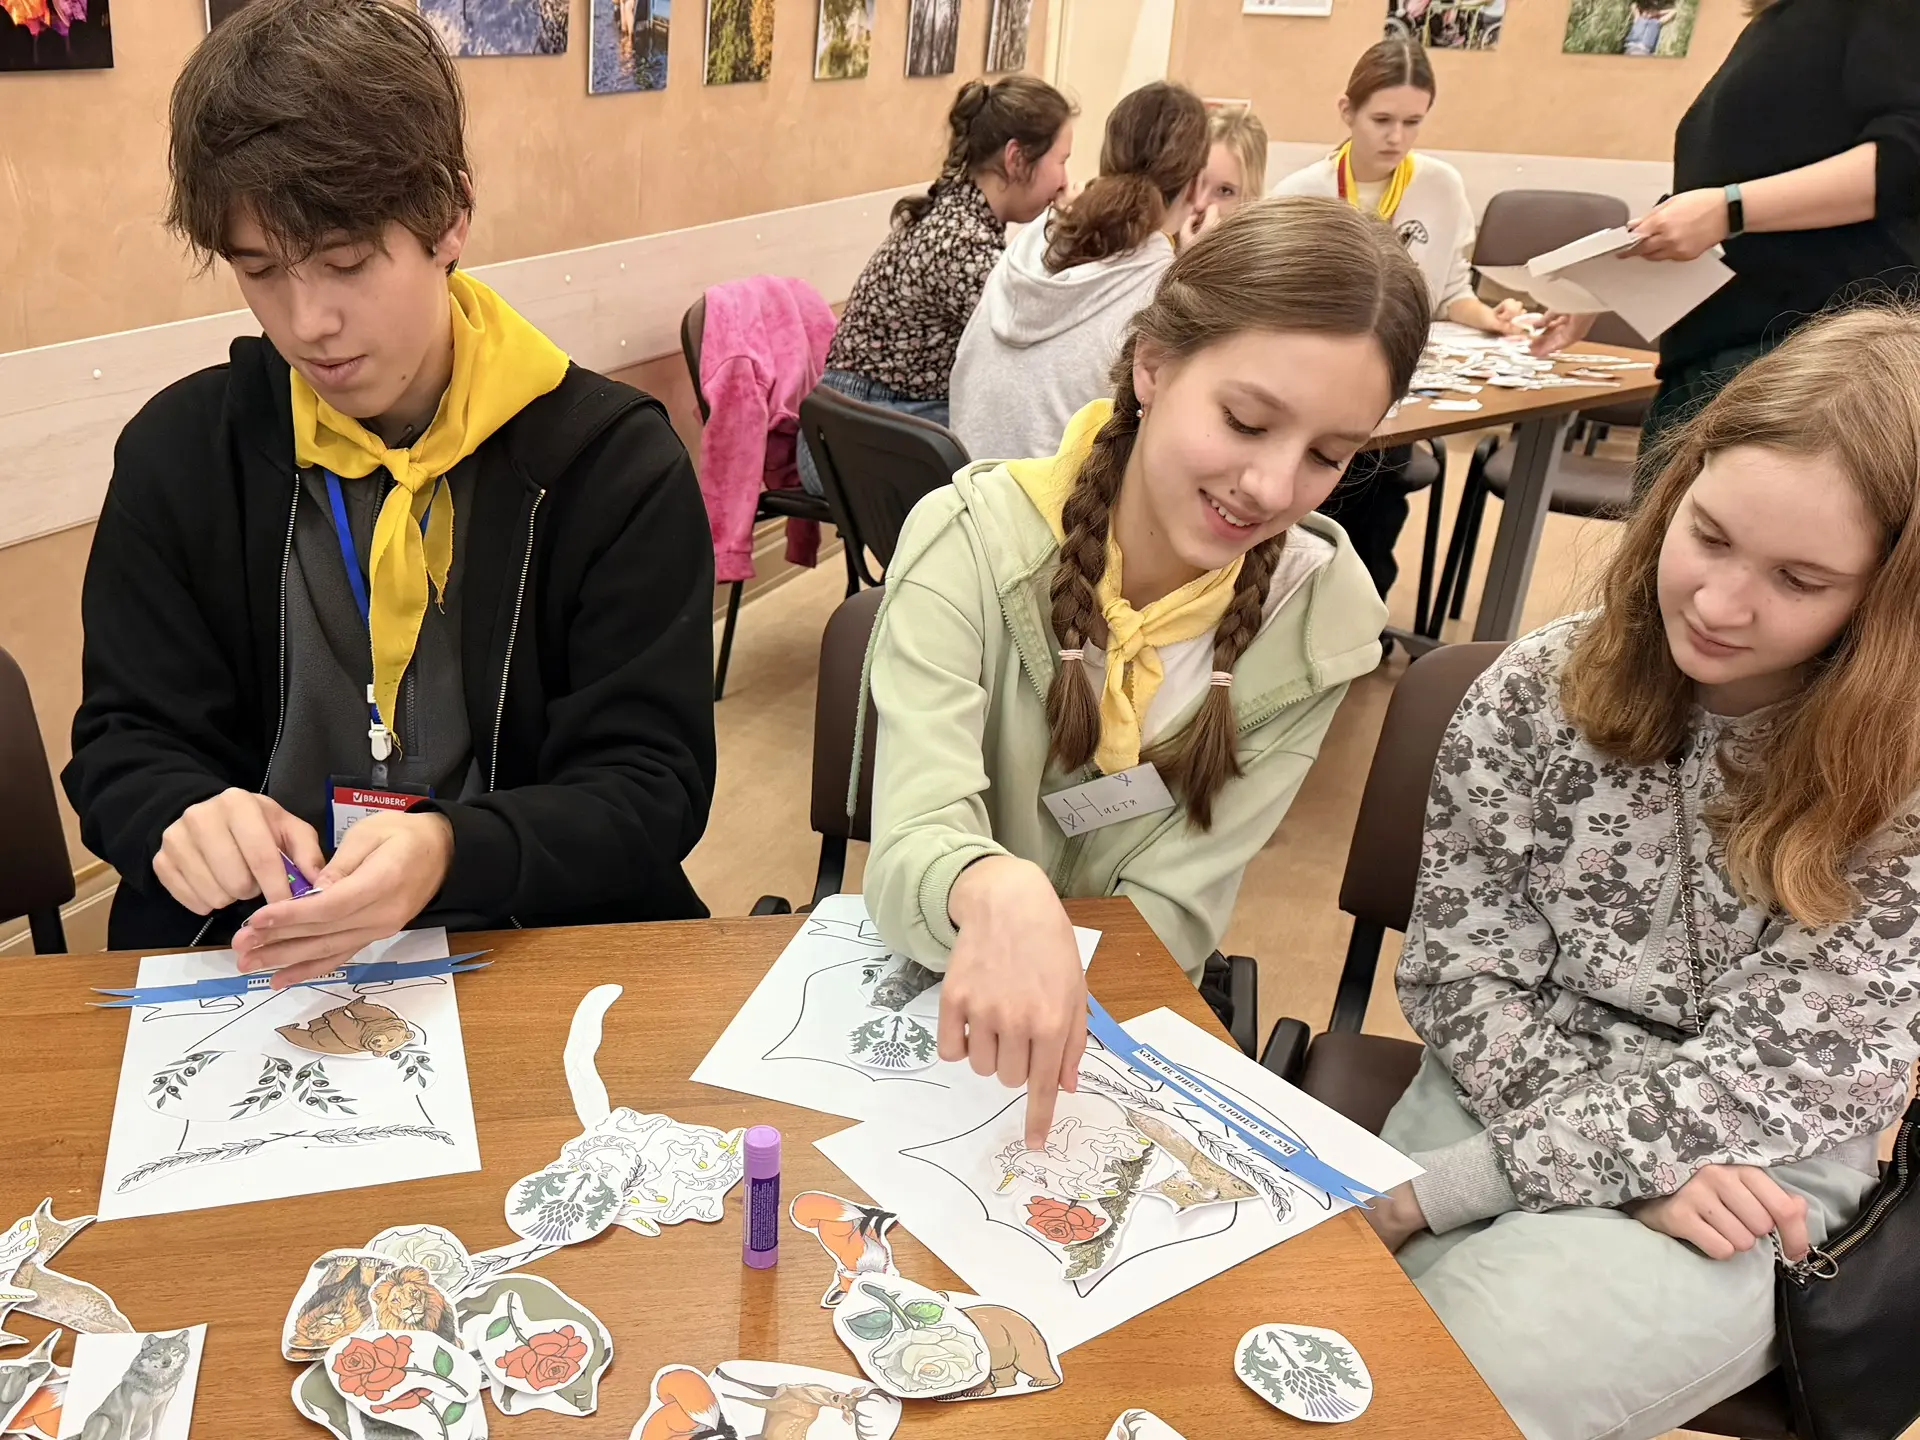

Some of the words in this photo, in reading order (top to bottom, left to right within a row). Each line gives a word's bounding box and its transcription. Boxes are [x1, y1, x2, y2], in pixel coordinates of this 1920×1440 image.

[363, 794, 406, 807] BRAUBERG
[1138, 1049, 1162, 1066] всех
[1161, 1066, 1176, 1076] за
[1175, 1074, 1203, 1093] один
[1217, 1103, 1259, 1130] одного
[1259, 1129, 1275, 1140] за
[1273, 1139, 1298, 1155] Все
